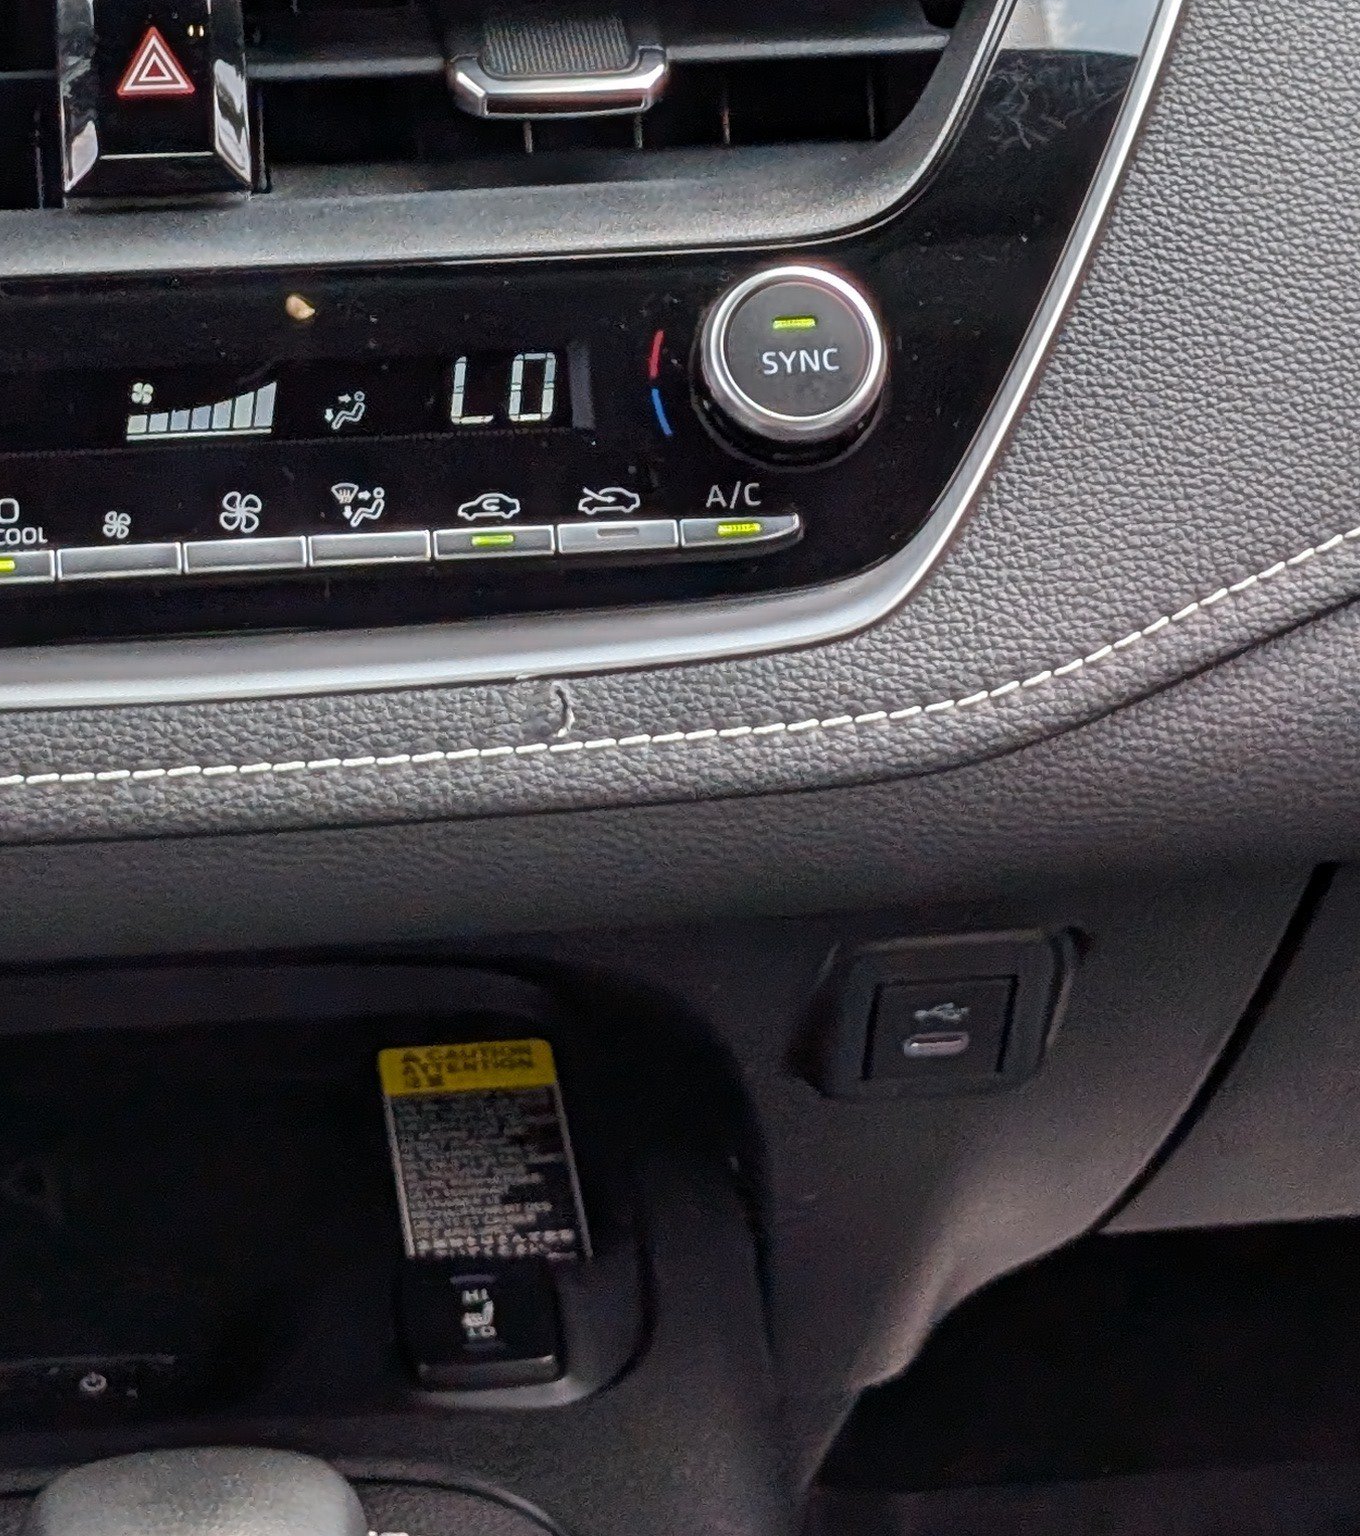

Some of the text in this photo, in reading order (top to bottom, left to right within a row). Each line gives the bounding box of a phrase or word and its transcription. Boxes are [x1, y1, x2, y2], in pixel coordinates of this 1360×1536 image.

[762, 348, 841, 375] SYNC
[450, 352, 557, 425] LO
[705, 482, 762, 510] A/C
[462, 1287, 490, 1305] HI
